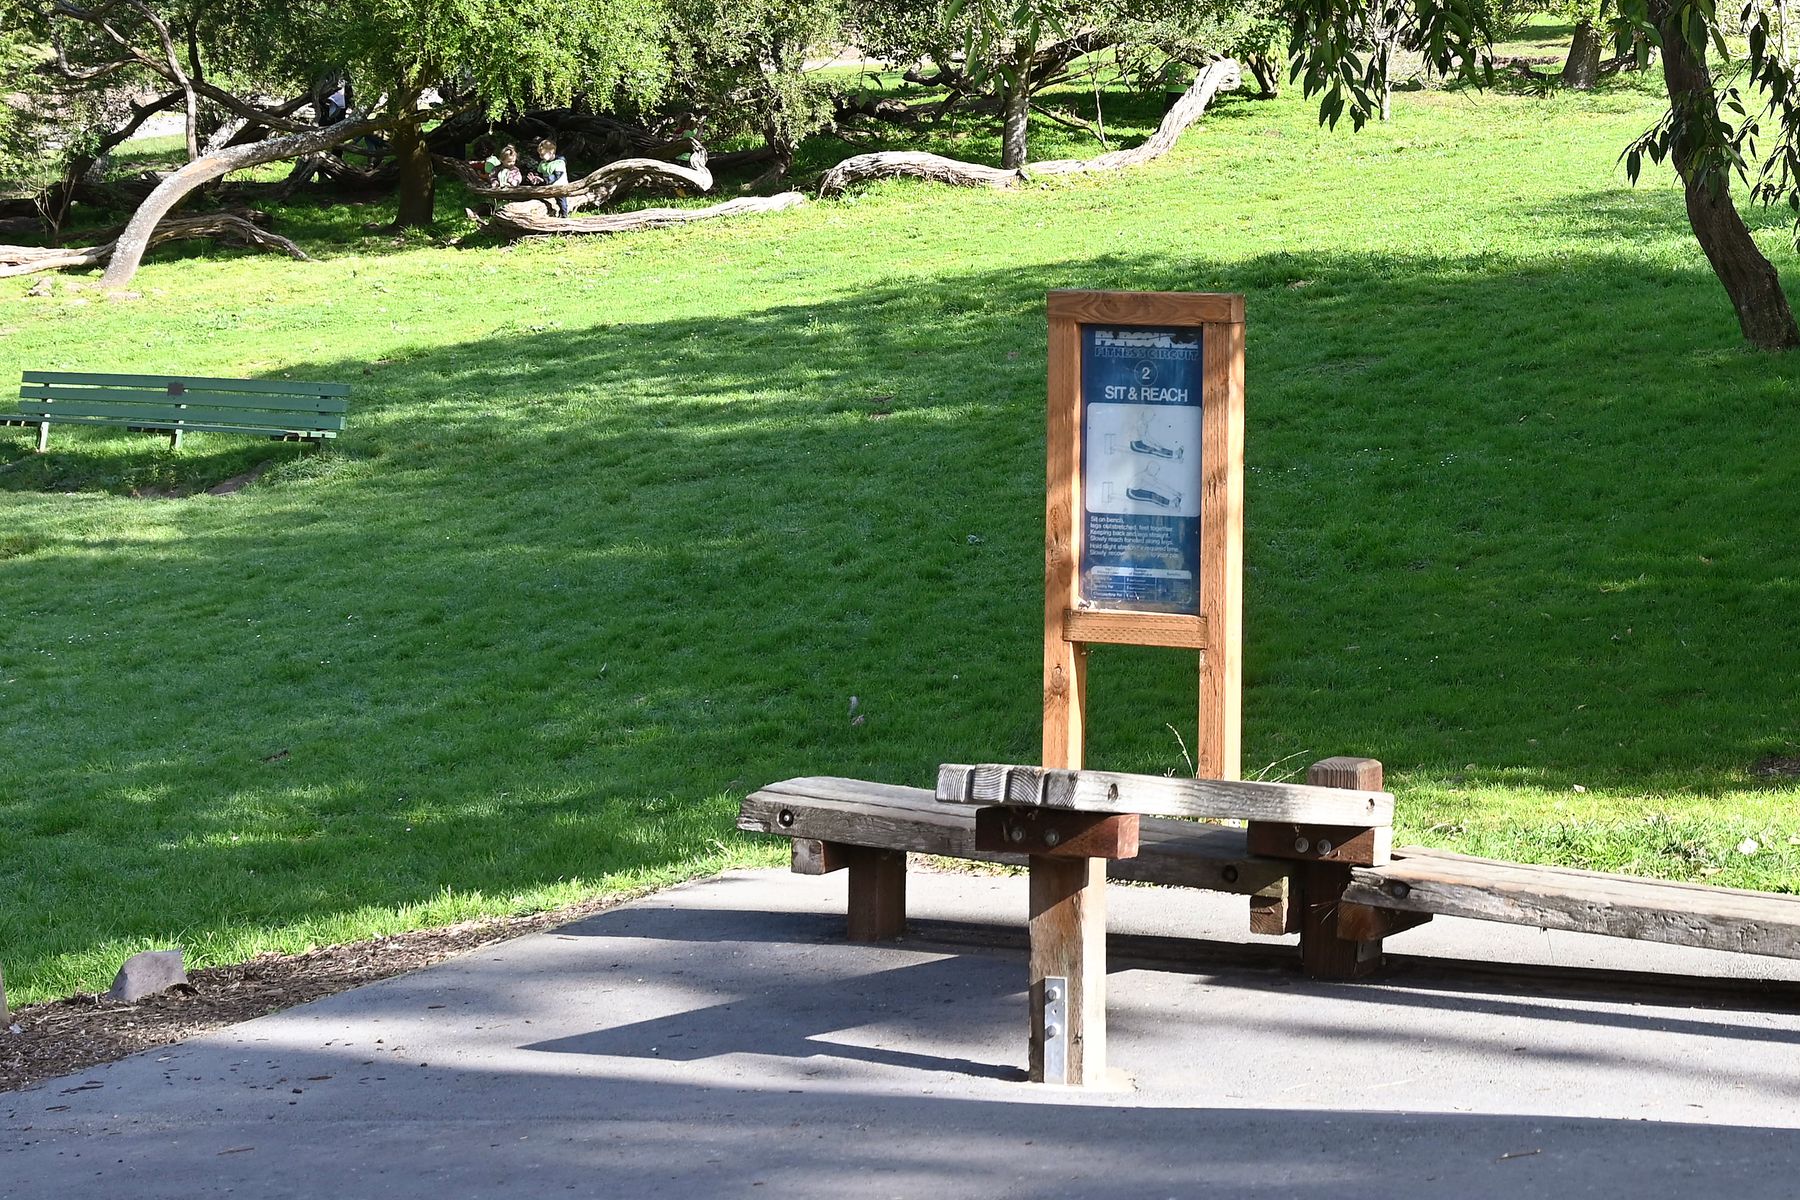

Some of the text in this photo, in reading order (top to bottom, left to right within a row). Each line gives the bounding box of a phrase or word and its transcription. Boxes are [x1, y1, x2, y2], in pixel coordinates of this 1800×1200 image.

[1095, 346, 1198, 360] FITNESS CIRCUIT
[1141, 367, 1151, 380] 2
[1105, 385, 1188, 402] SIT & REACH
